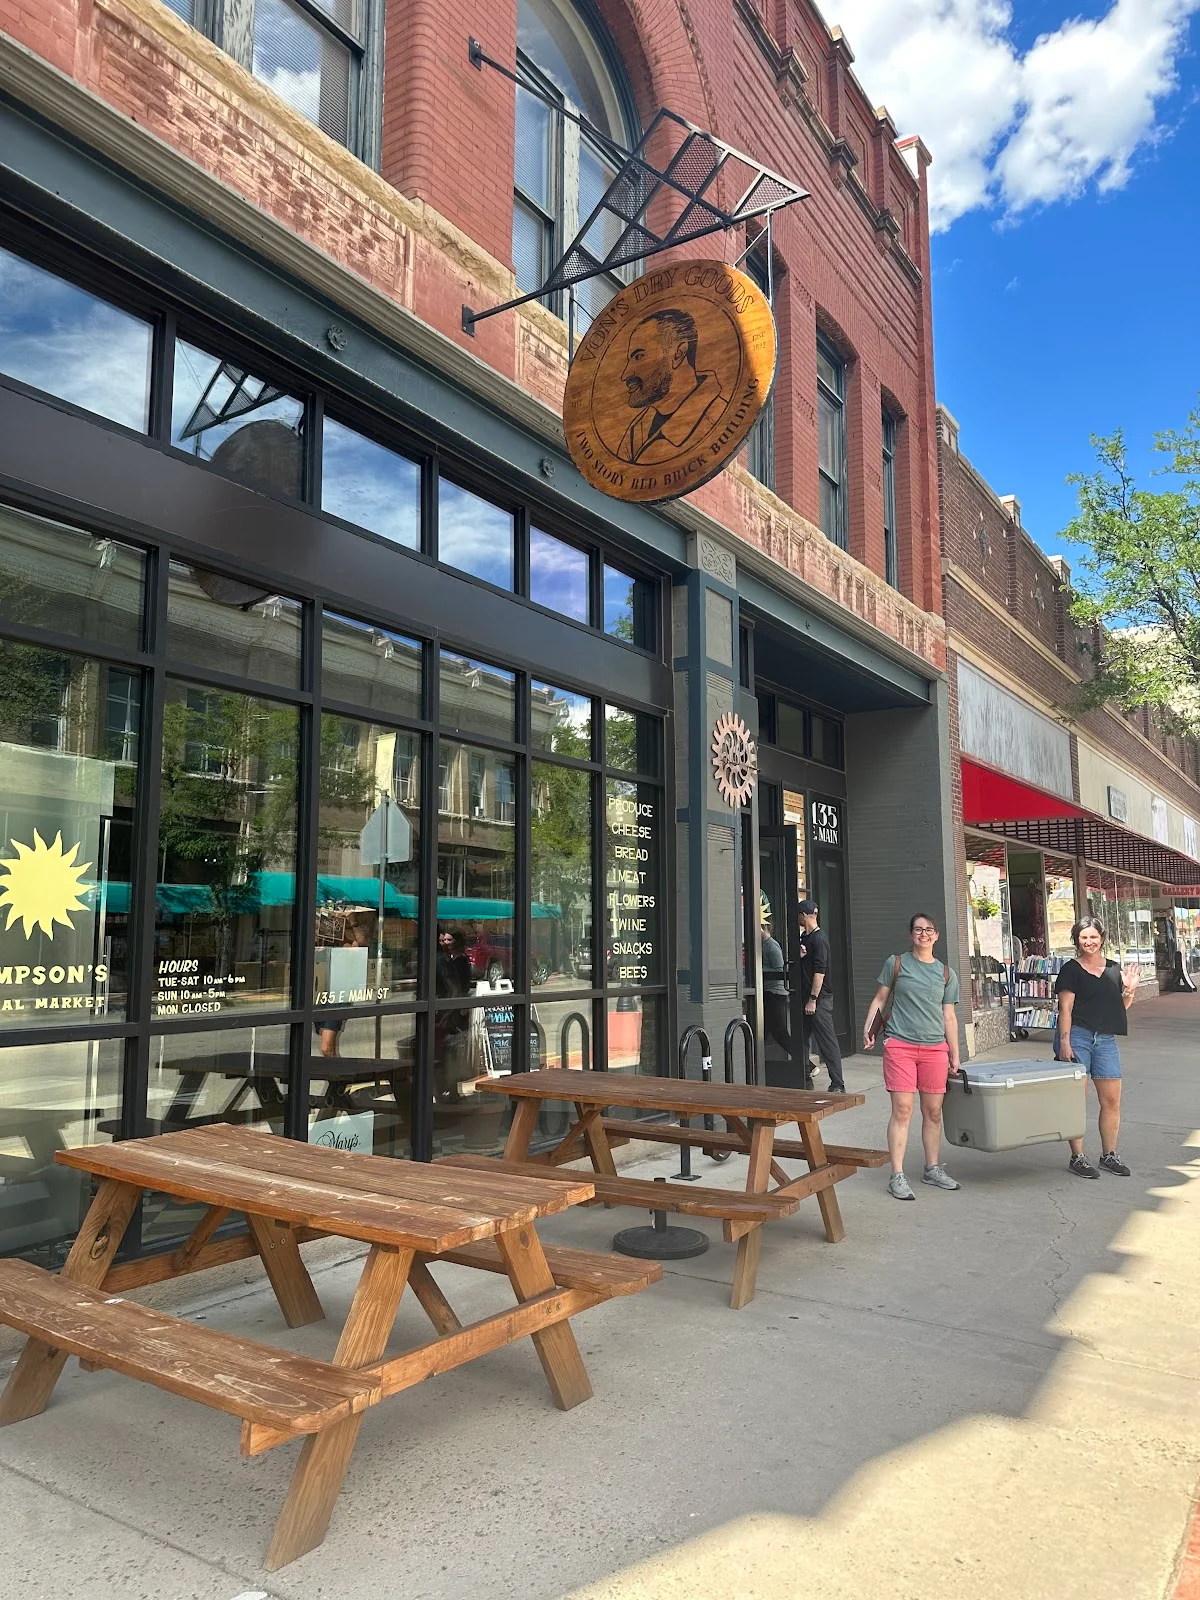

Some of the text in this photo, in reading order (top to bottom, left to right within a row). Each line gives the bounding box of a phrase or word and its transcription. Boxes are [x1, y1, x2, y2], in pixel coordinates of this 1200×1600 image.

[580, 265, 755, 362] VON'S DRY GOODS
[576, 378, 759, 490] TWO STORY RED BRICK BUILDING
[608, 797, 654, 818] PRODUCE
[811, 801, 838, 829] 135
[611, 822, 652, 840] CHEESE
[818, 826, 838, 844] MAIN
[614, 845, 649, 862] BREAD
[618, 870, 647, 884] MEAT
[1162, 886, 1195, 896] GALLERY
[608, 892, 655, 908] FLOWERS
[610, 918, 647, 932] TWINE
[612, 942, 653, 955] SNACKS
[158, 959, 199, 974] HOURS
[619, 965, 648, 979] BEES
[157, 975, 200, 988] TUE-SAT
[35, 996, 105, 1009] MARKET
[157, 990, 178, 1001] SUN
[315, 987, 390, 1005] 135 E MAIN ST
[157, 1001, 221, 1016] MON CLOSED
